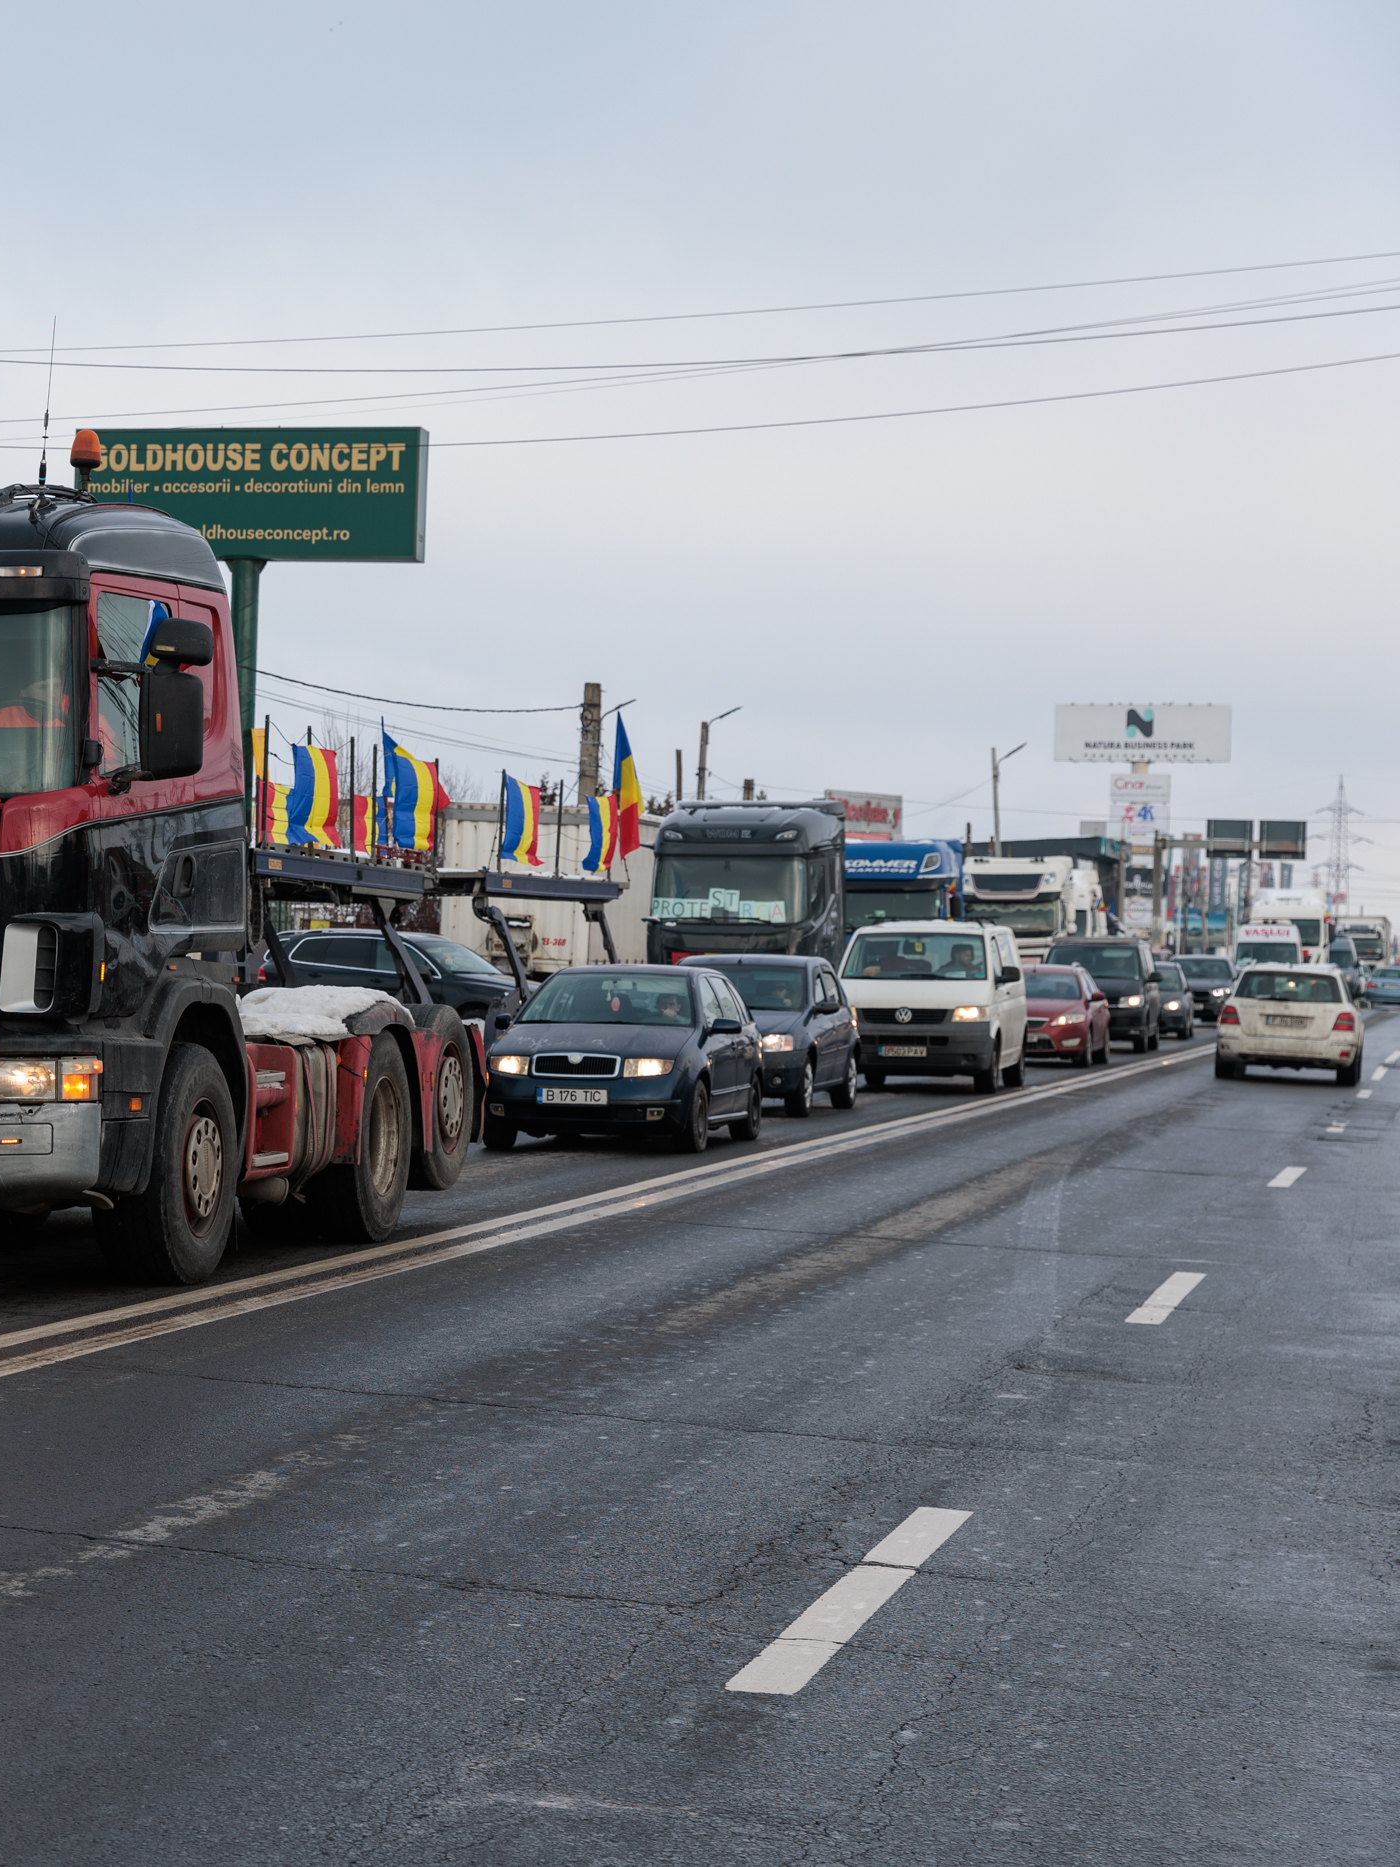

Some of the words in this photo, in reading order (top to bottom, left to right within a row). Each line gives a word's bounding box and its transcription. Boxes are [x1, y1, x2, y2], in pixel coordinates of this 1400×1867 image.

[270, 443, 406, 472] CONCEPT
[162, 478, 232, 494] accesorii
[244, 477, 332, 494] decoratiuni
[337, 477, 361, 494] din
[366, 478, 405, 494] lemn
[1085, 741, 1121, 750] NATURA
[1124, 741, 1168, 750] BUSINESS
[1171, 741, 1195, 750] PARK
[742, 903, 784, 919] RCA
[1244, 928, 1291, 938] VASLUI
[546, 1090, 555, 1102] B
[559, 1091, 577, 1102] 176
[583, 1091, 602, 1102] TIC
